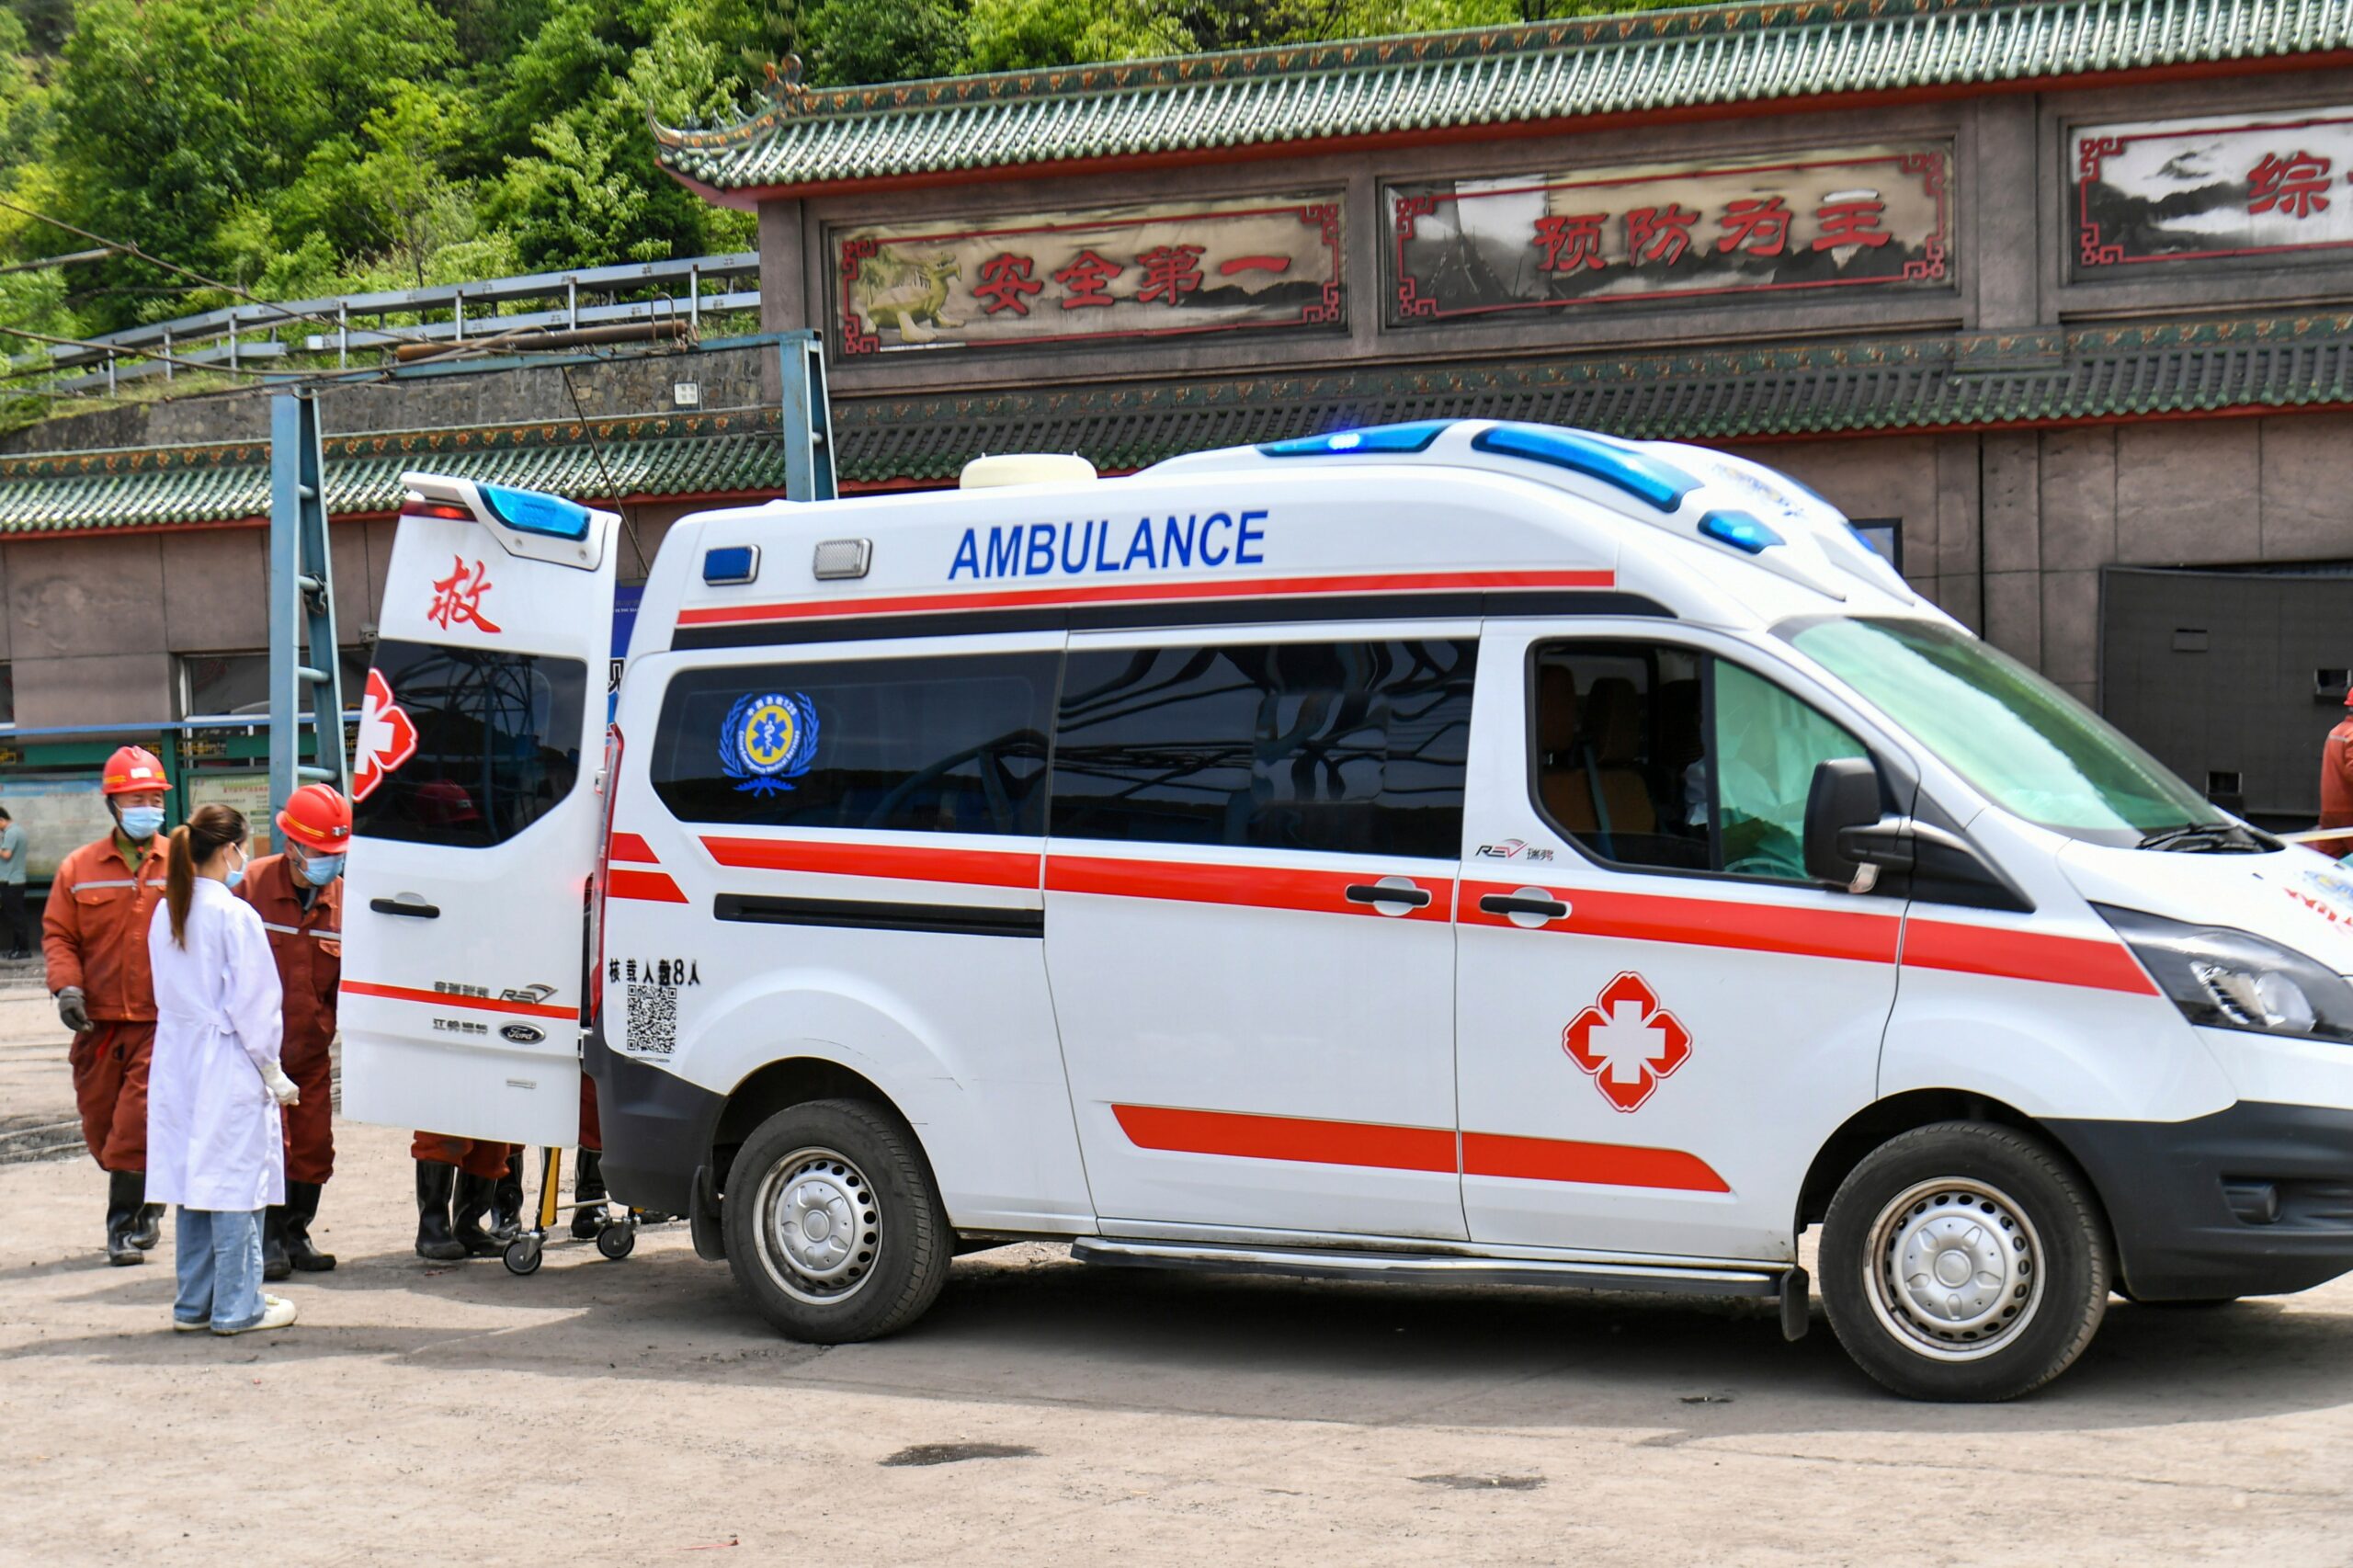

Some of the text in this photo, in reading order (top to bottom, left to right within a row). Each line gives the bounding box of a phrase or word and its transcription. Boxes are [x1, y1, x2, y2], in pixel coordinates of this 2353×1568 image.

[2246, 150, 2353, 219] 综
[973, 244, 1291, 316] 安全第一
[948, 510, 1268, 581] AMBULANCE
[427, 554, 502, 633] 救
[1475, 838, 1529, 858] REV
[499, 983, 558, 1004] REV
[507, 1027, 534, 1040] Ford
